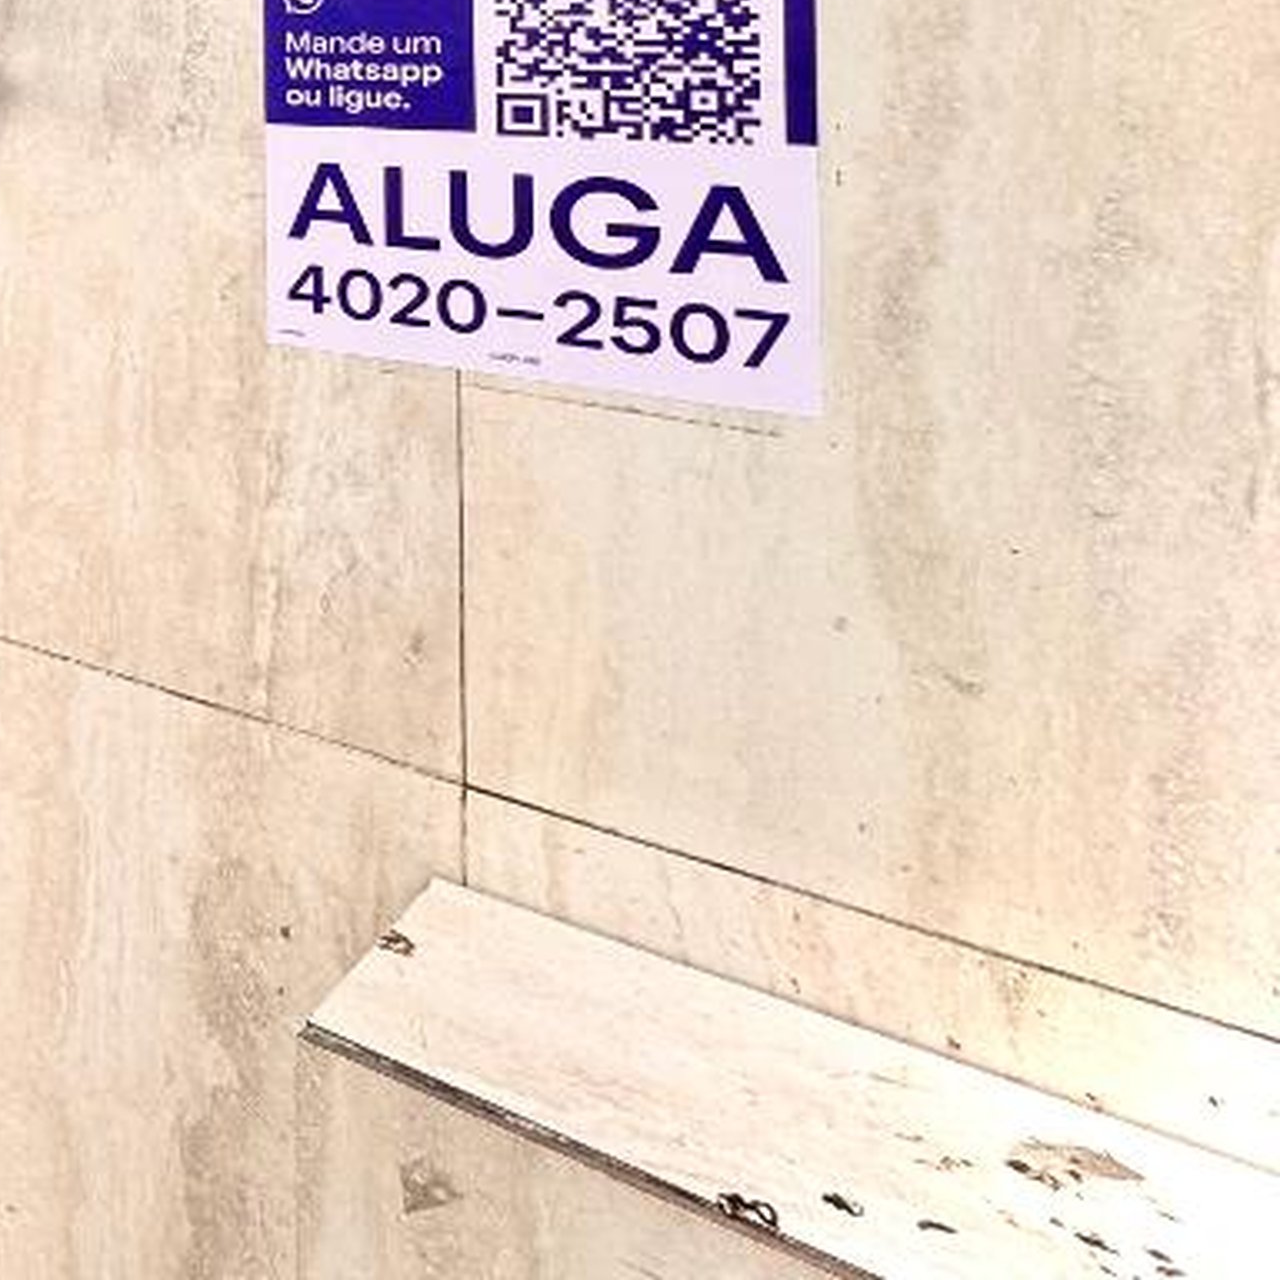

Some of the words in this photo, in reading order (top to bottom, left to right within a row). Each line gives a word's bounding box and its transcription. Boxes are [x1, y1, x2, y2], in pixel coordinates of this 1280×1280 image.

[285, 30, 385, 55] Mande
[392, 35, 442, 55] um
[285, 57, 444, 88] Whatsapp
[285, 87, 322, 108] ou
[328, 84, 412, 115] ligue.
[287, 162, 790, 284] ALUGA
[287, 264, 792, 370] 4020-2507
